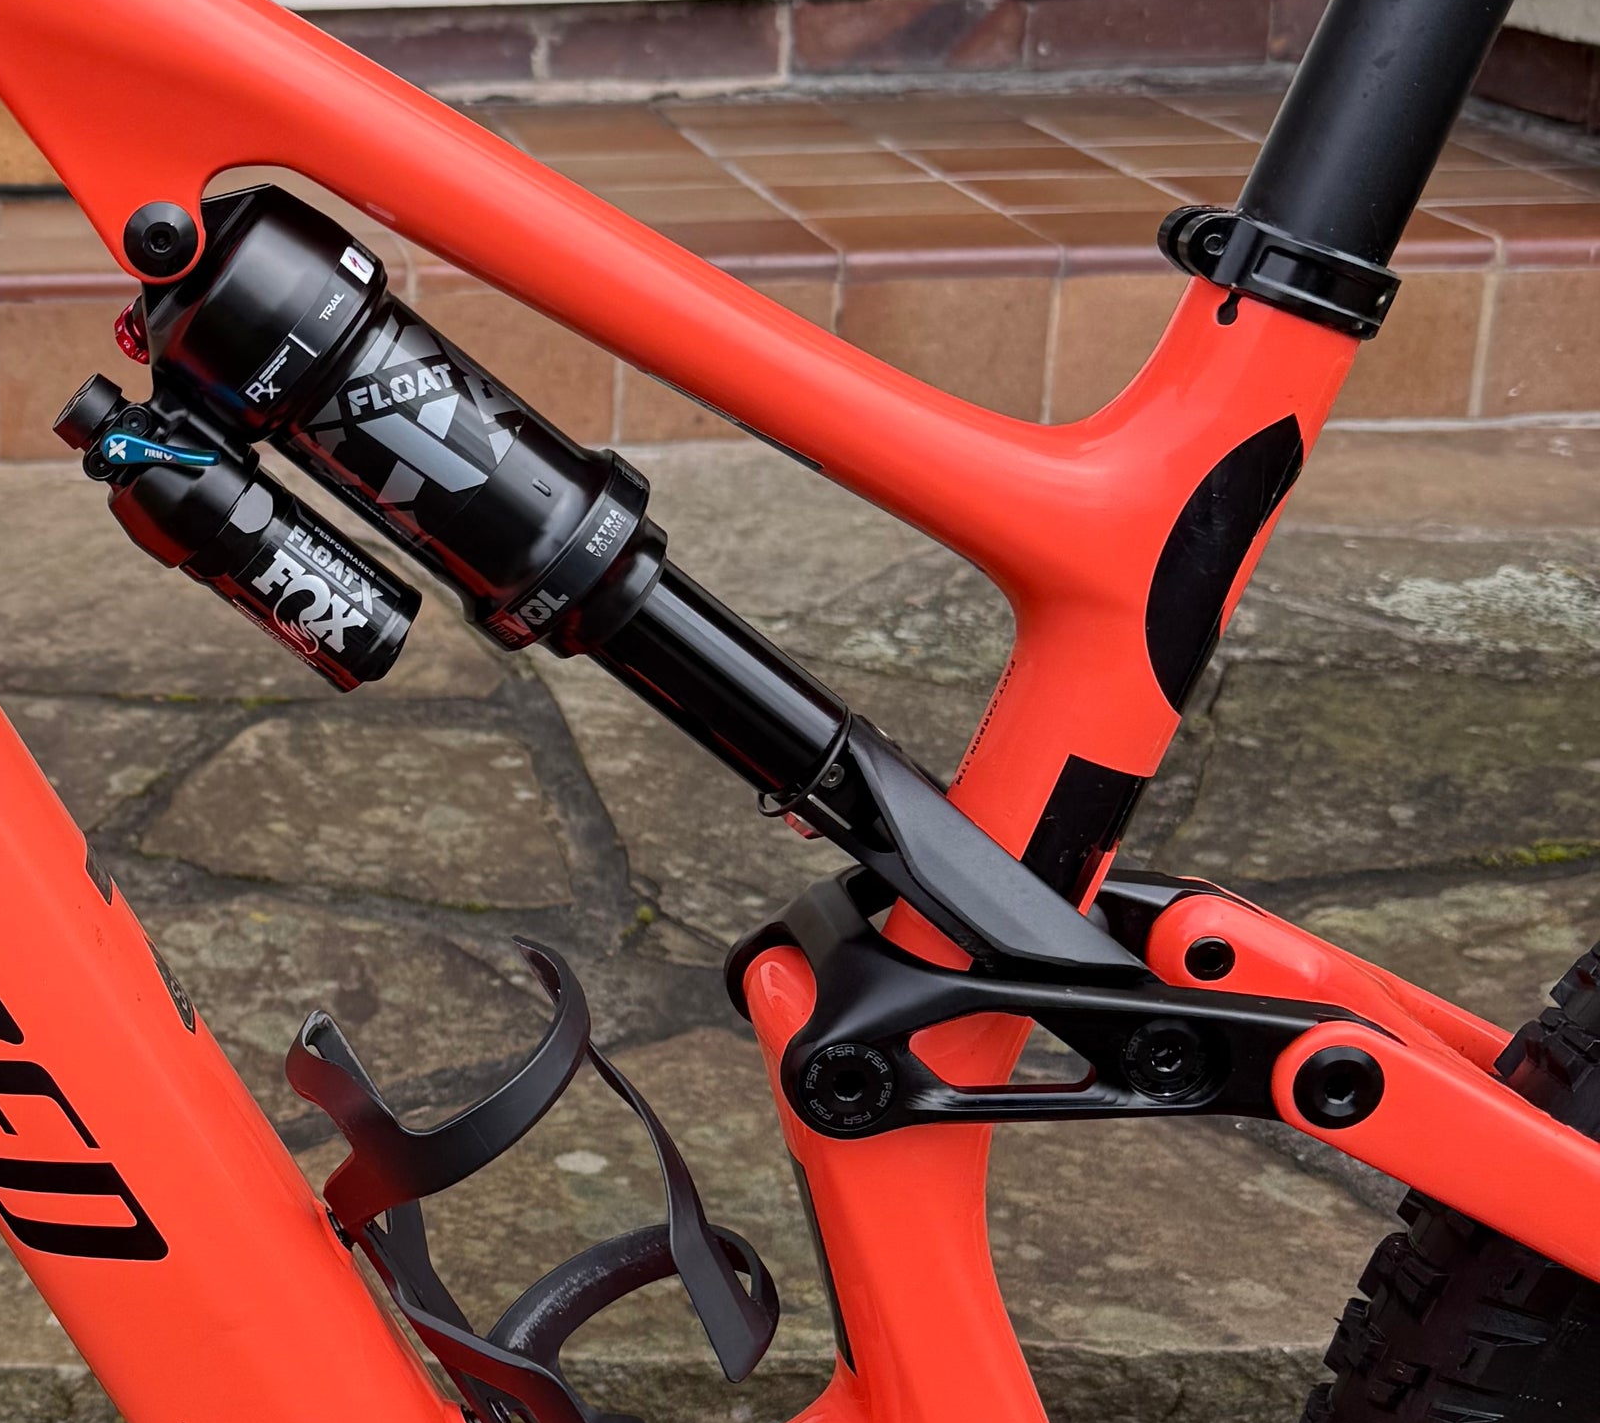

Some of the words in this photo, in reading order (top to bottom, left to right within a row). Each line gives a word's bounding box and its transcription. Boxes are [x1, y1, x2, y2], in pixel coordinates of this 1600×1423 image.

[318, 293, 345, 321] TRAIL
[346, 363, 453, 417] FLOAT
[144, 448, 163, 460] FIRM
[585, 509, 621, 554] EXTRA
[593, 513, 627, 558] VOLUME
[313, 526, 376, 579] PERFORMANCE
[251, 549, 369, 654] FOX
[826, 1046, 855, 1061] FSR
[864, 1051, 889, 1074] FSR
[805, 1063, 823, 1090] FSR
[876, 1081, 893, 1108] FSR
[809, 1098, 834, 1121] FSR
[843, 1111, 872, 1125] FSR
